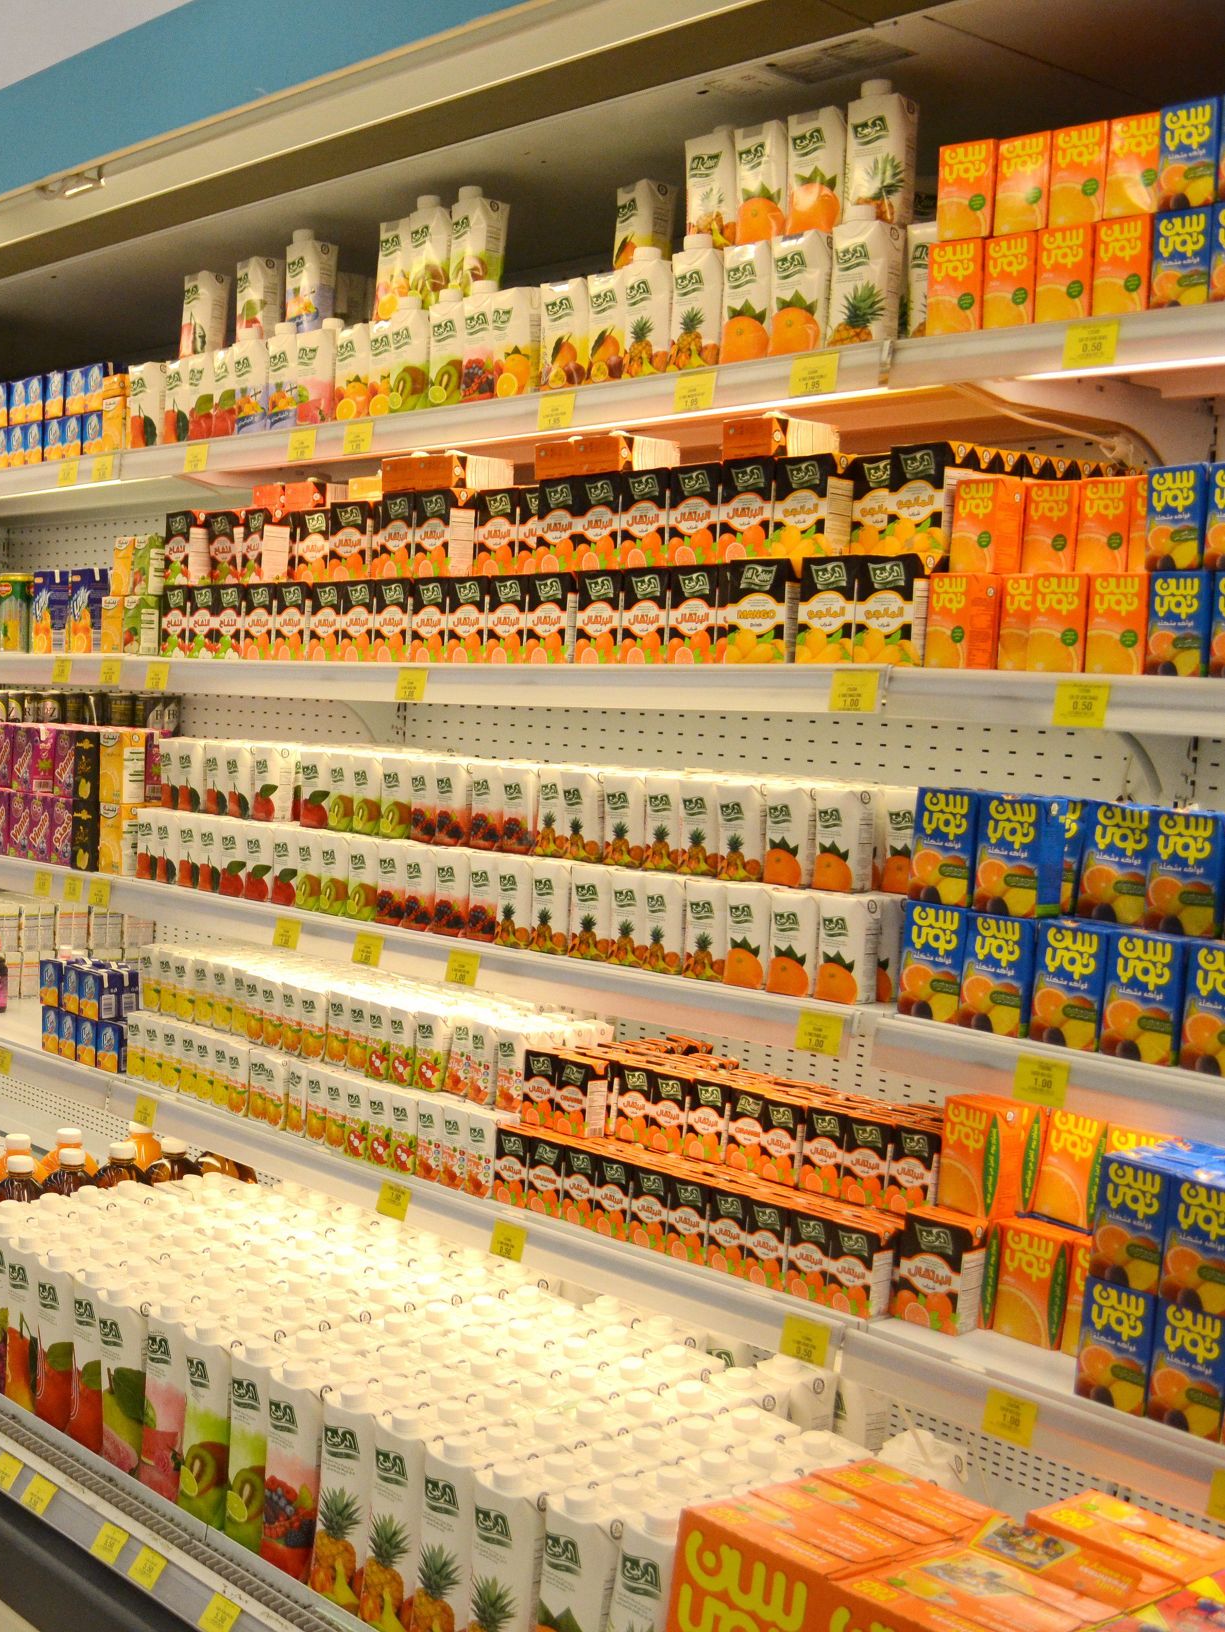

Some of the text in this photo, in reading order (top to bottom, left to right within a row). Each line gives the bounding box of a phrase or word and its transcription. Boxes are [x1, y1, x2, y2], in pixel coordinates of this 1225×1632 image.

[737, 609, 776, 620] MANGO
[14, 742, 32, 778] Vimto
[55, 745, 75, 782] Vimto
[10, 809, 29, 844] Vimto
[29, 812, 49, 847] Vimto
[808, 1038, 824, 1049] 1.00
[1034, 1078, 1052, 1089] 1.00
